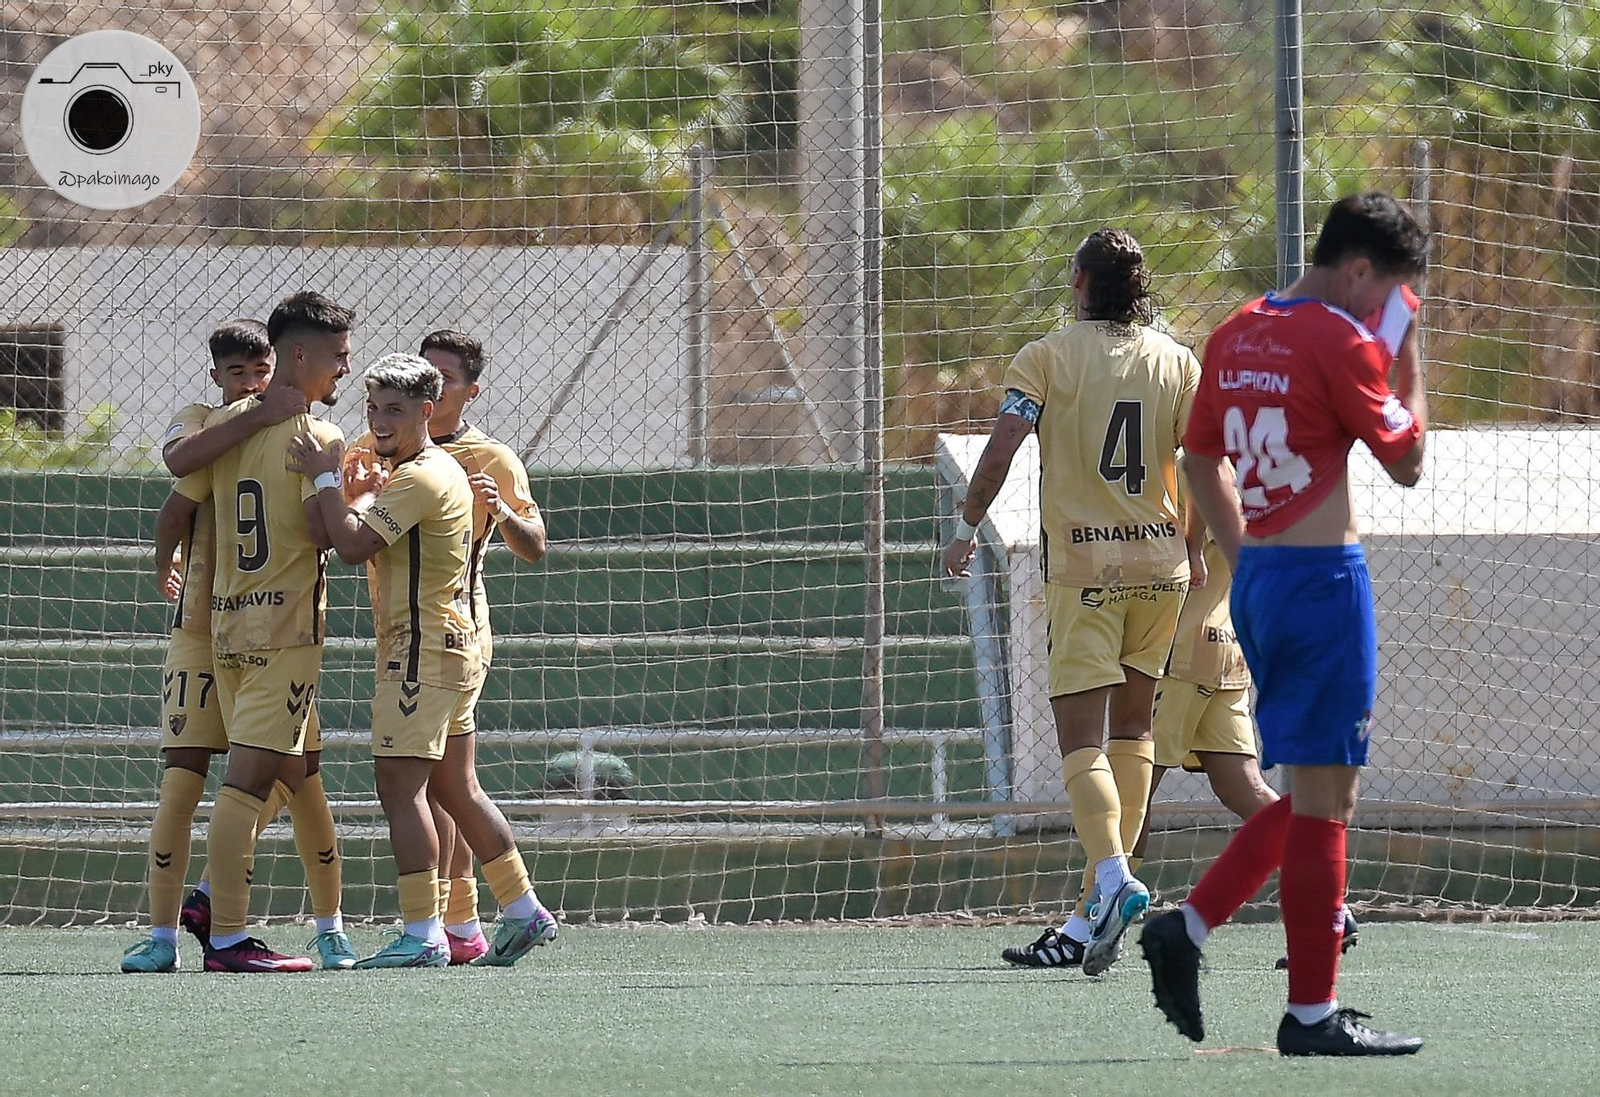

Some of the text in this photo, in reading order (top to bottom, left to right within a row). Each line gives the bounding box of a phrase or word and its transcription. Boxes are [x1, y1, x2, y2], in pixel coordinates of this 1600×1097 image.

[1218, 368, 1290, 395] LUPION
[1097, 400, 1147, 496] 4
[1223, 405, 1313, 508] 24
[237, 478, 270, 573] 9
[1071, 521, 1176, 544] BENAHAVIS
[176, 670, 216, 710] 17
